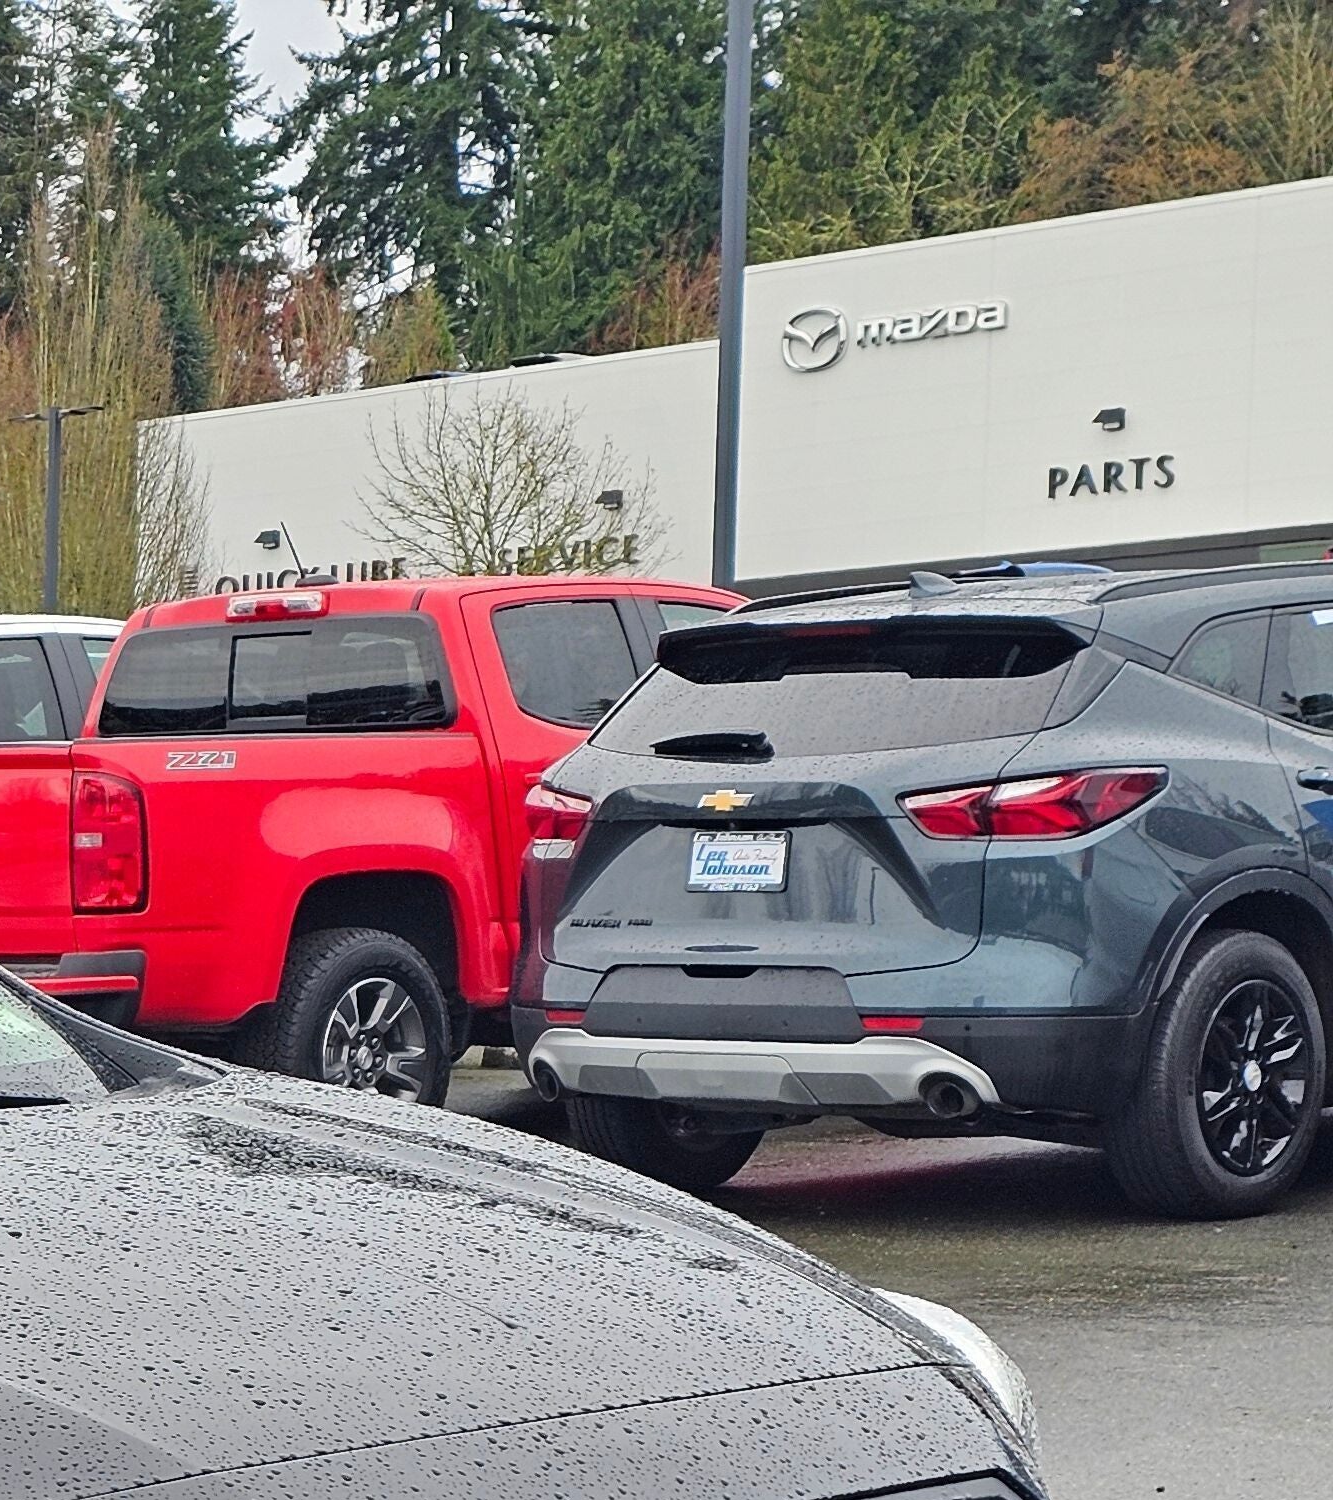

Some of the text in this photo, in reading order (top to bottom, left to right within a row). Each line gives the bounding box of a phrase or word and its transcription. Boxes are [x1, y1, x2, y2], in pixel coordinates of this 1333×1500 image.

[1048, 454, 1176, 500] PARTS
[498, 533, 641, 577] SERVICE
[166, 750, 237, 770] Z71
[696, 843, 730, 862] Lee
[696, 856, 773, 876] Johnson
